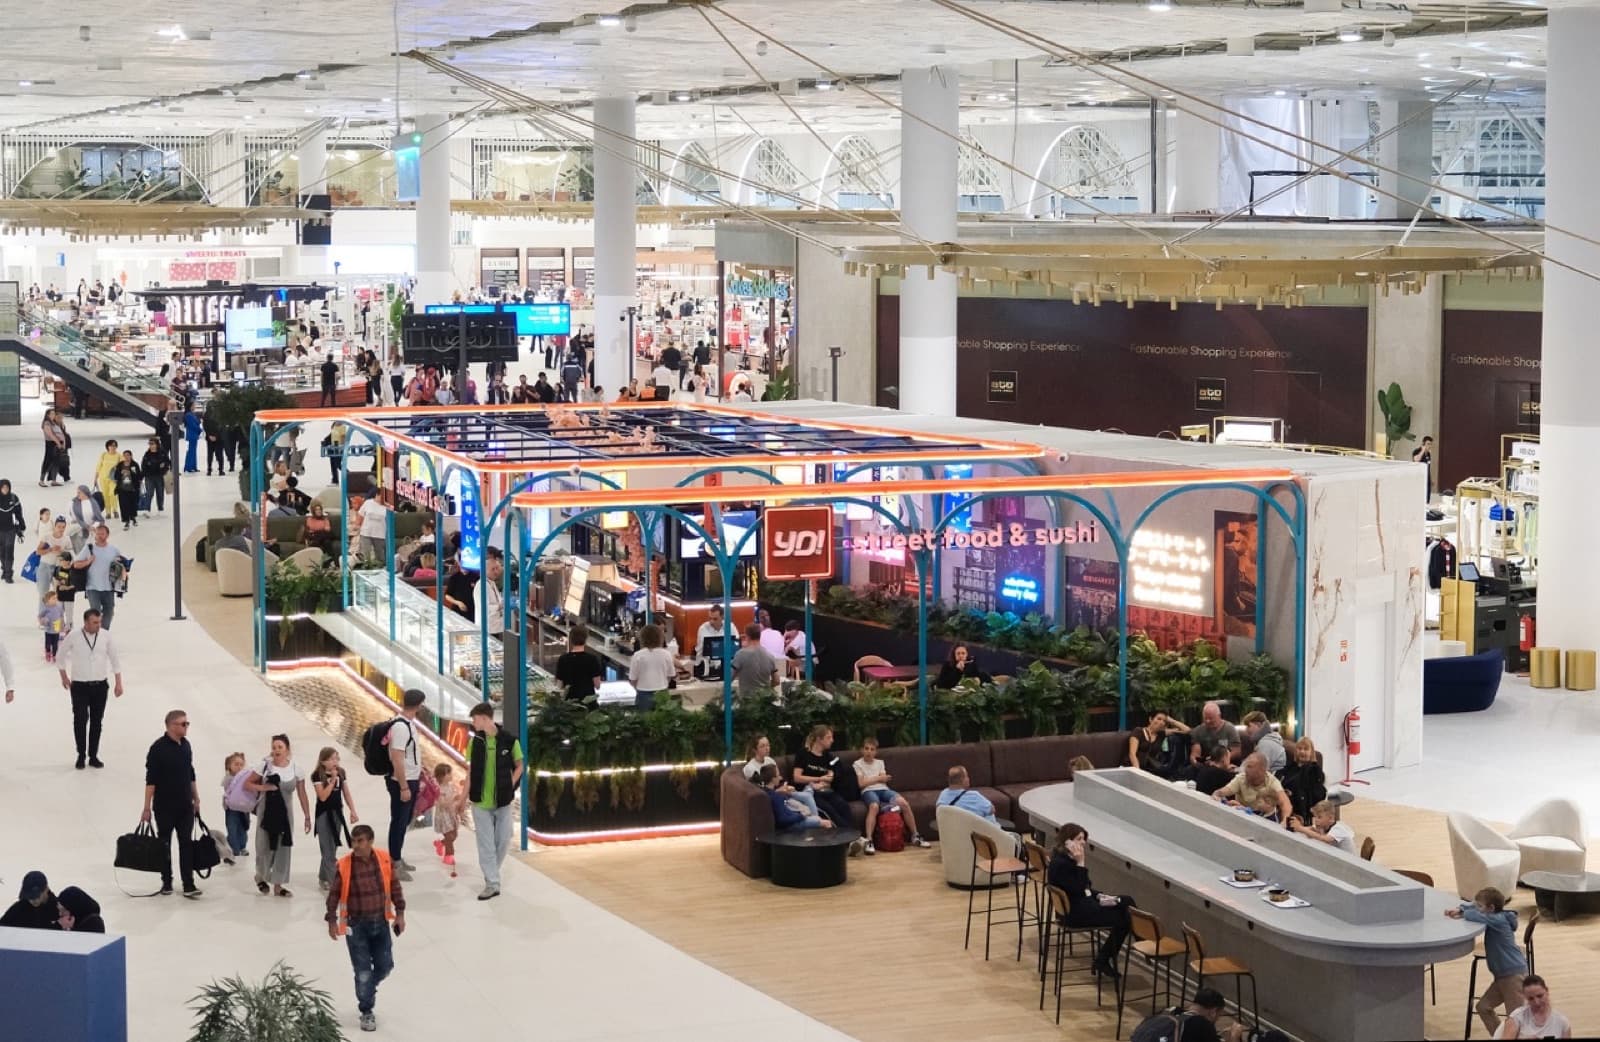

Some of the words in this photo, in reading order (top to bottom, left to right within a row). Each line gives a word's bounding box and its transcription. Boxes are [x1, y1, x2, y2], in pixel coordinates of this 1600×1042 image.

[983, 340, 1028, 352] Shopping
[1130, 343, 1188, 355] Fashionable
[1190, 345, 1237, 358] Shopping
[1451, 353, 1511, 365] Fashionable
[852, 529, 937, 551] street
[942, 522, 1003, 550] food
[1009, 522, 1028, 546] &
[1036, 520, 1100, 546] sushi
